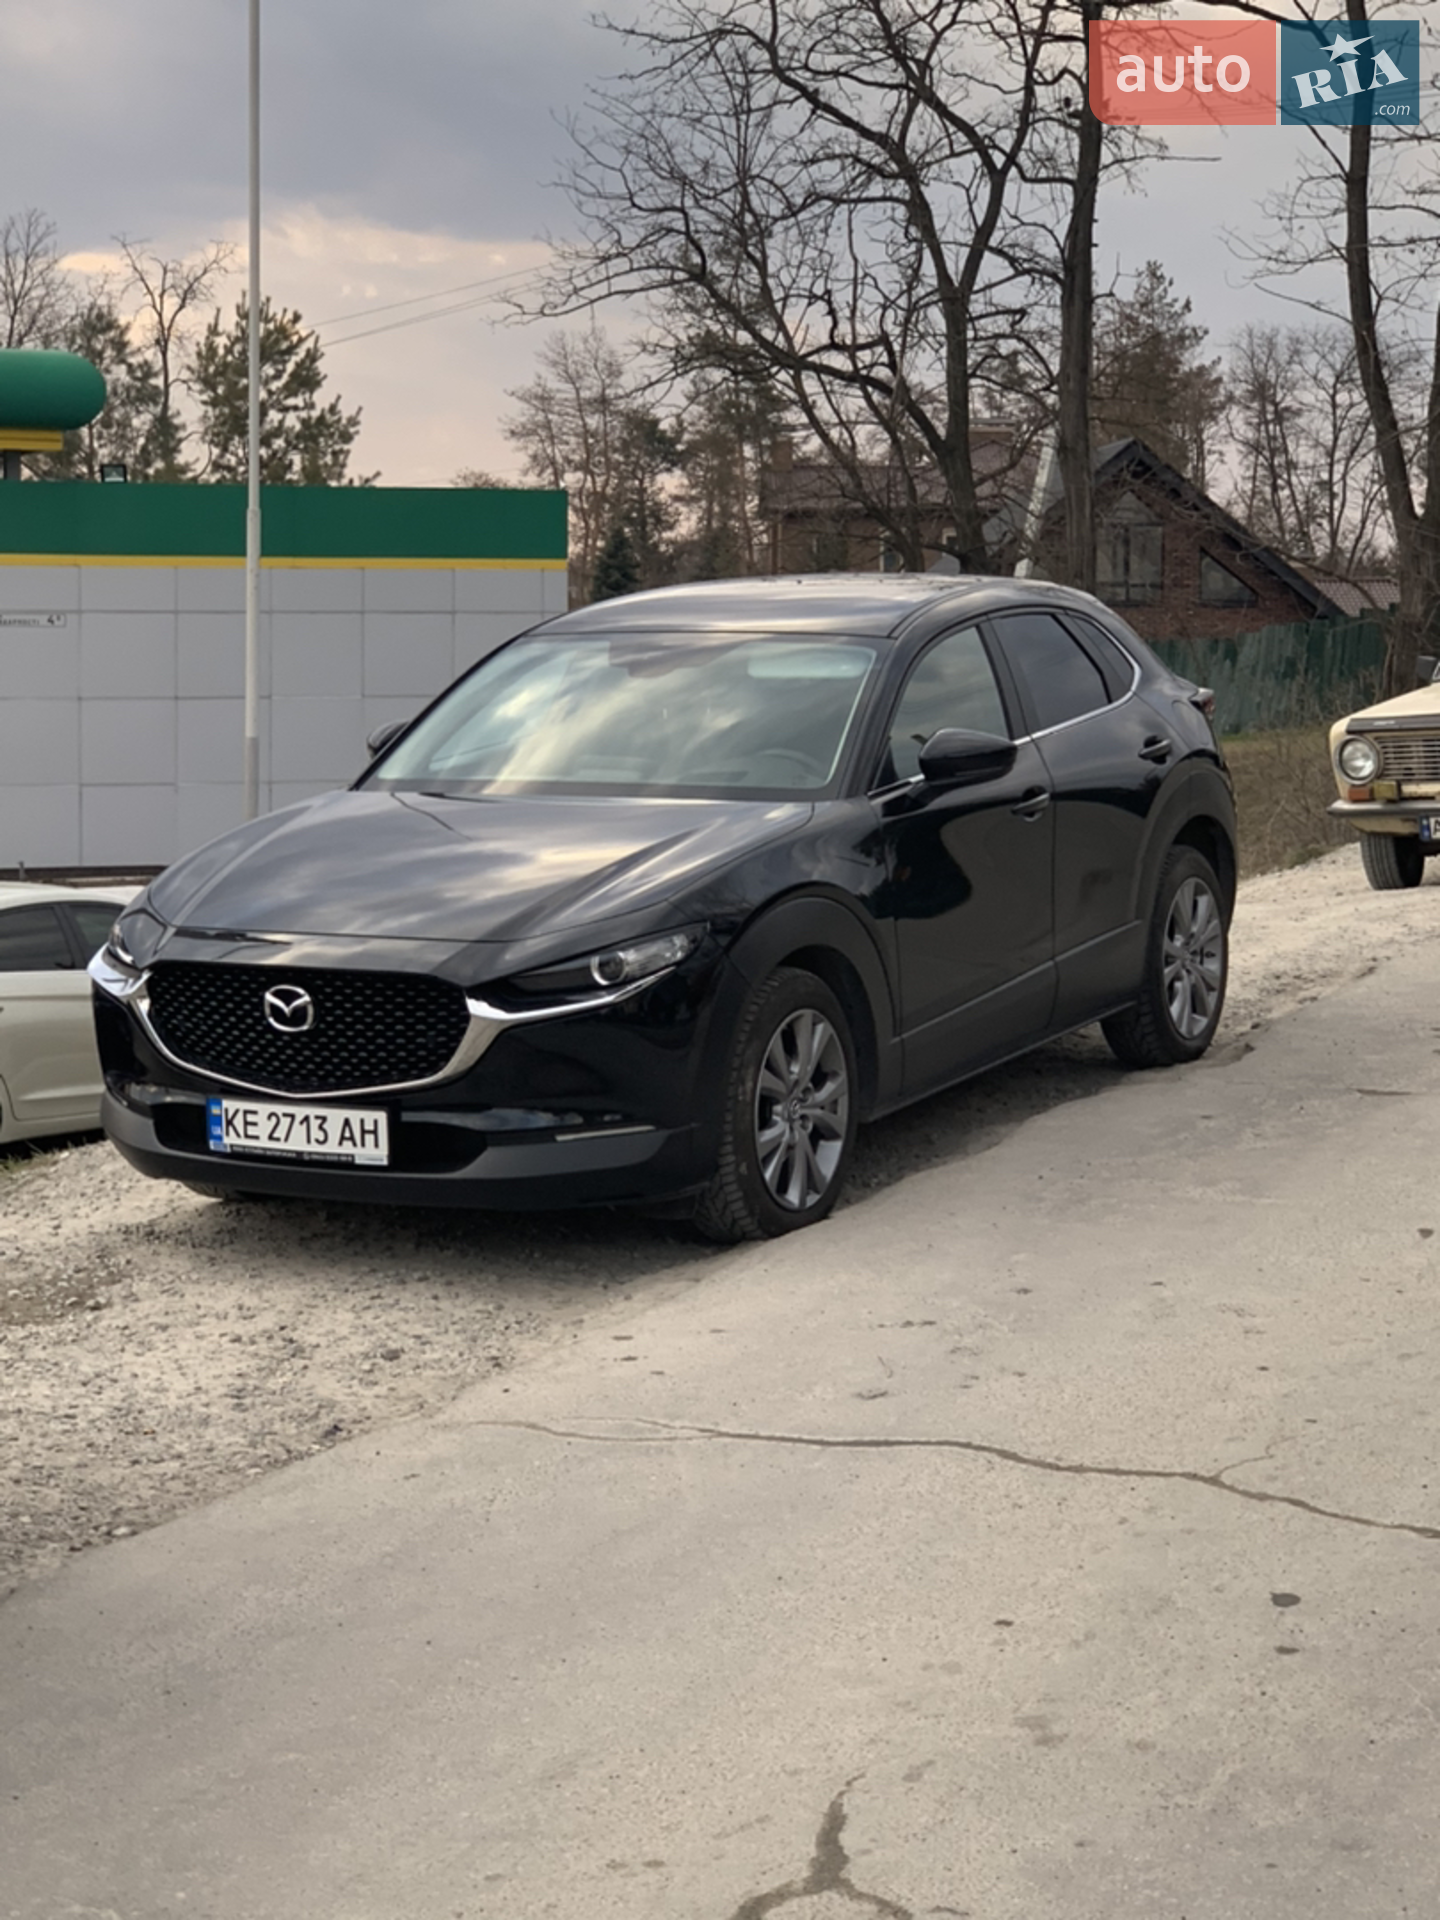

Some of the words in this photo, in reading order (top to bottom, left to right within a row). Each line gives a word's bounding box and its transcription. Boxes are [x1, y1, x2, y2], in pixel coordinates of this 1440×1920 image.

[224, 1107, 260, 1140] KE
[267, 1111, 329, 1145] 2713
[338, 1117, 379, 1149] AH
